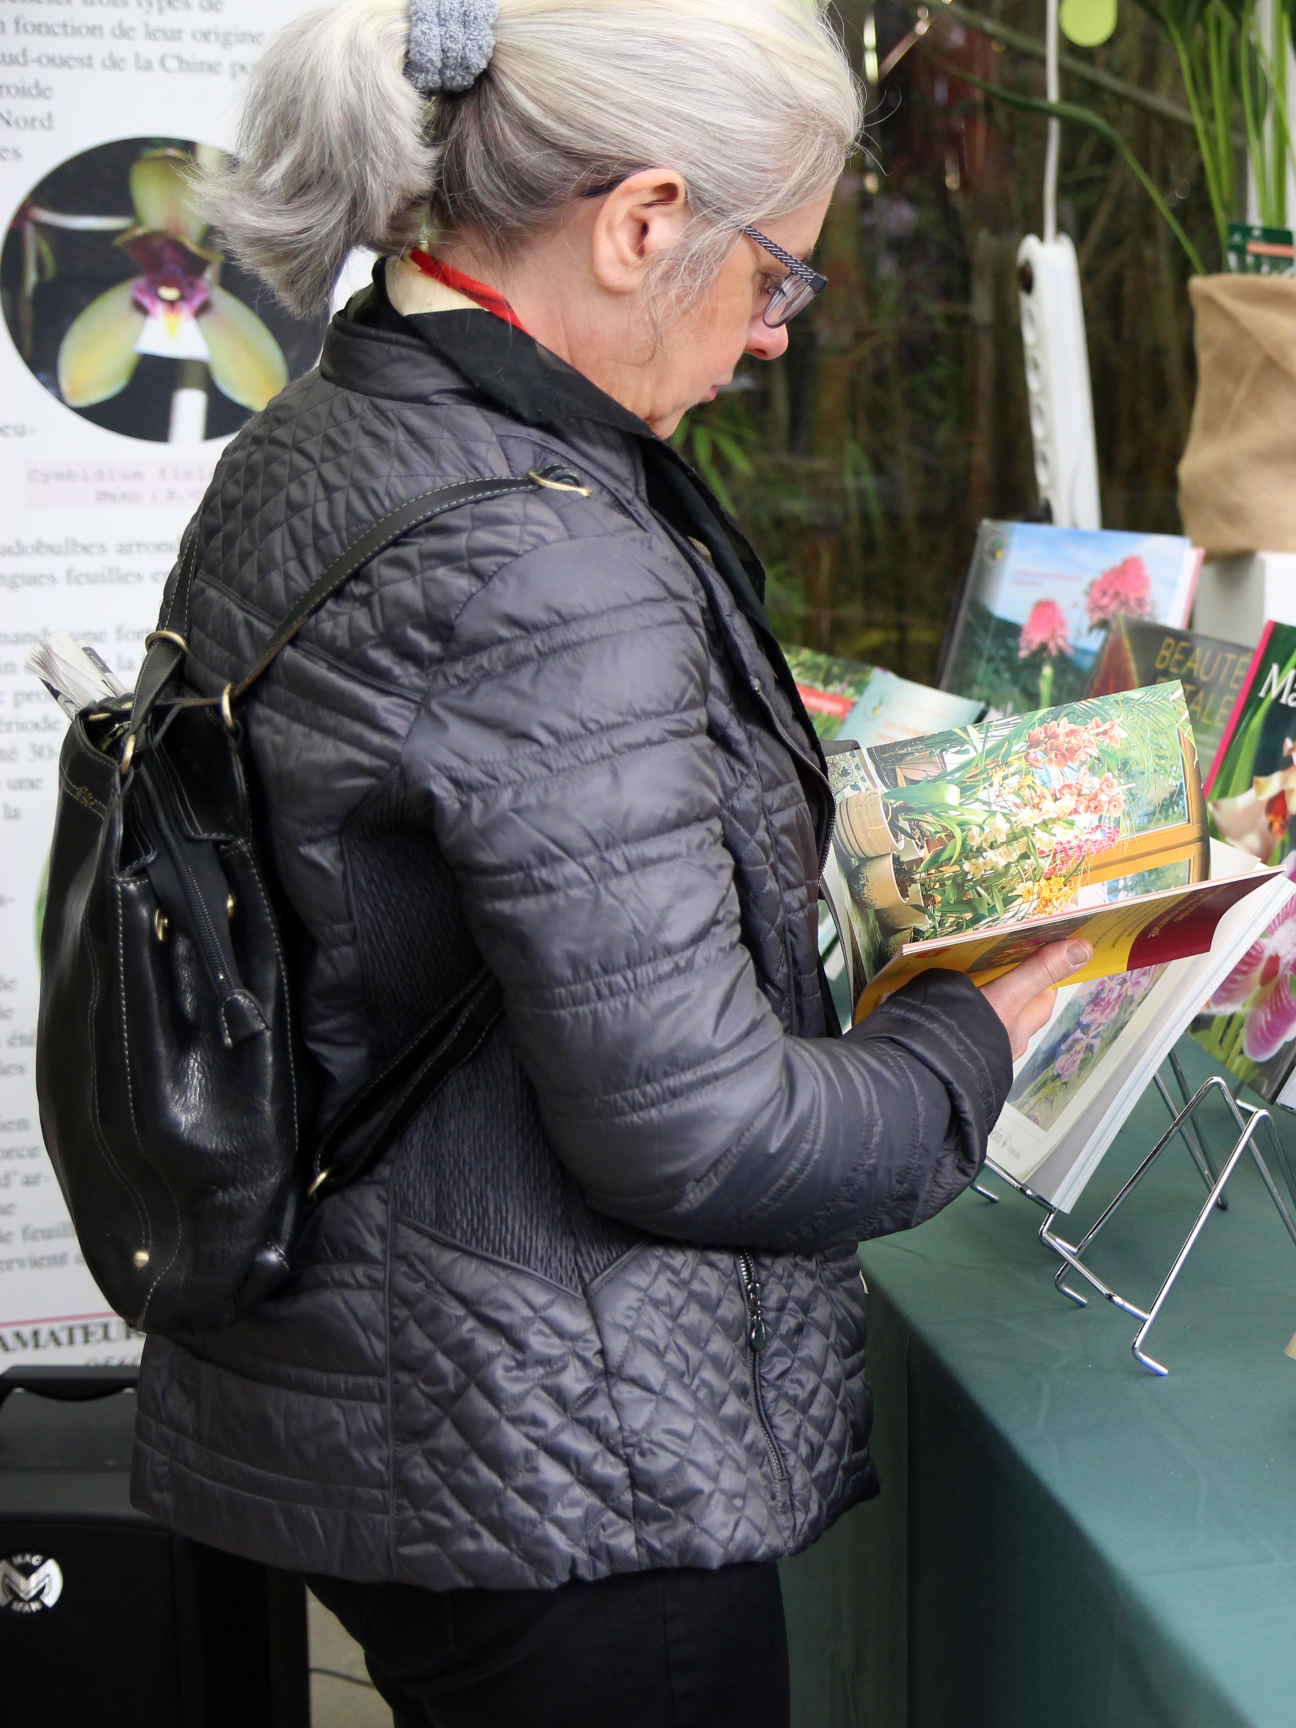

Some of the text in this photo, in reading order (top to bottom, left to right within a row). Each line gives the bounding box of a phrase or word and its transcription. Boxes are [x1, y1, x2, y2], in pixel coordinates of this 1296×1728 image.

[14, 16, 105, 39] fonction
[110, 20, 136, 41] de
[143, 22, 184, 42] leur
[190, 27, 266, 50] origine
[101, 52, 127, 72] de
[134, 52, 153, 72] la
[159, 53, 223, 75] Chine
[0, 81, 53, 99] roide
[66, 568, 145, 587] feuilles
[1155, 637, 1253, 689] BEAUTÉ
